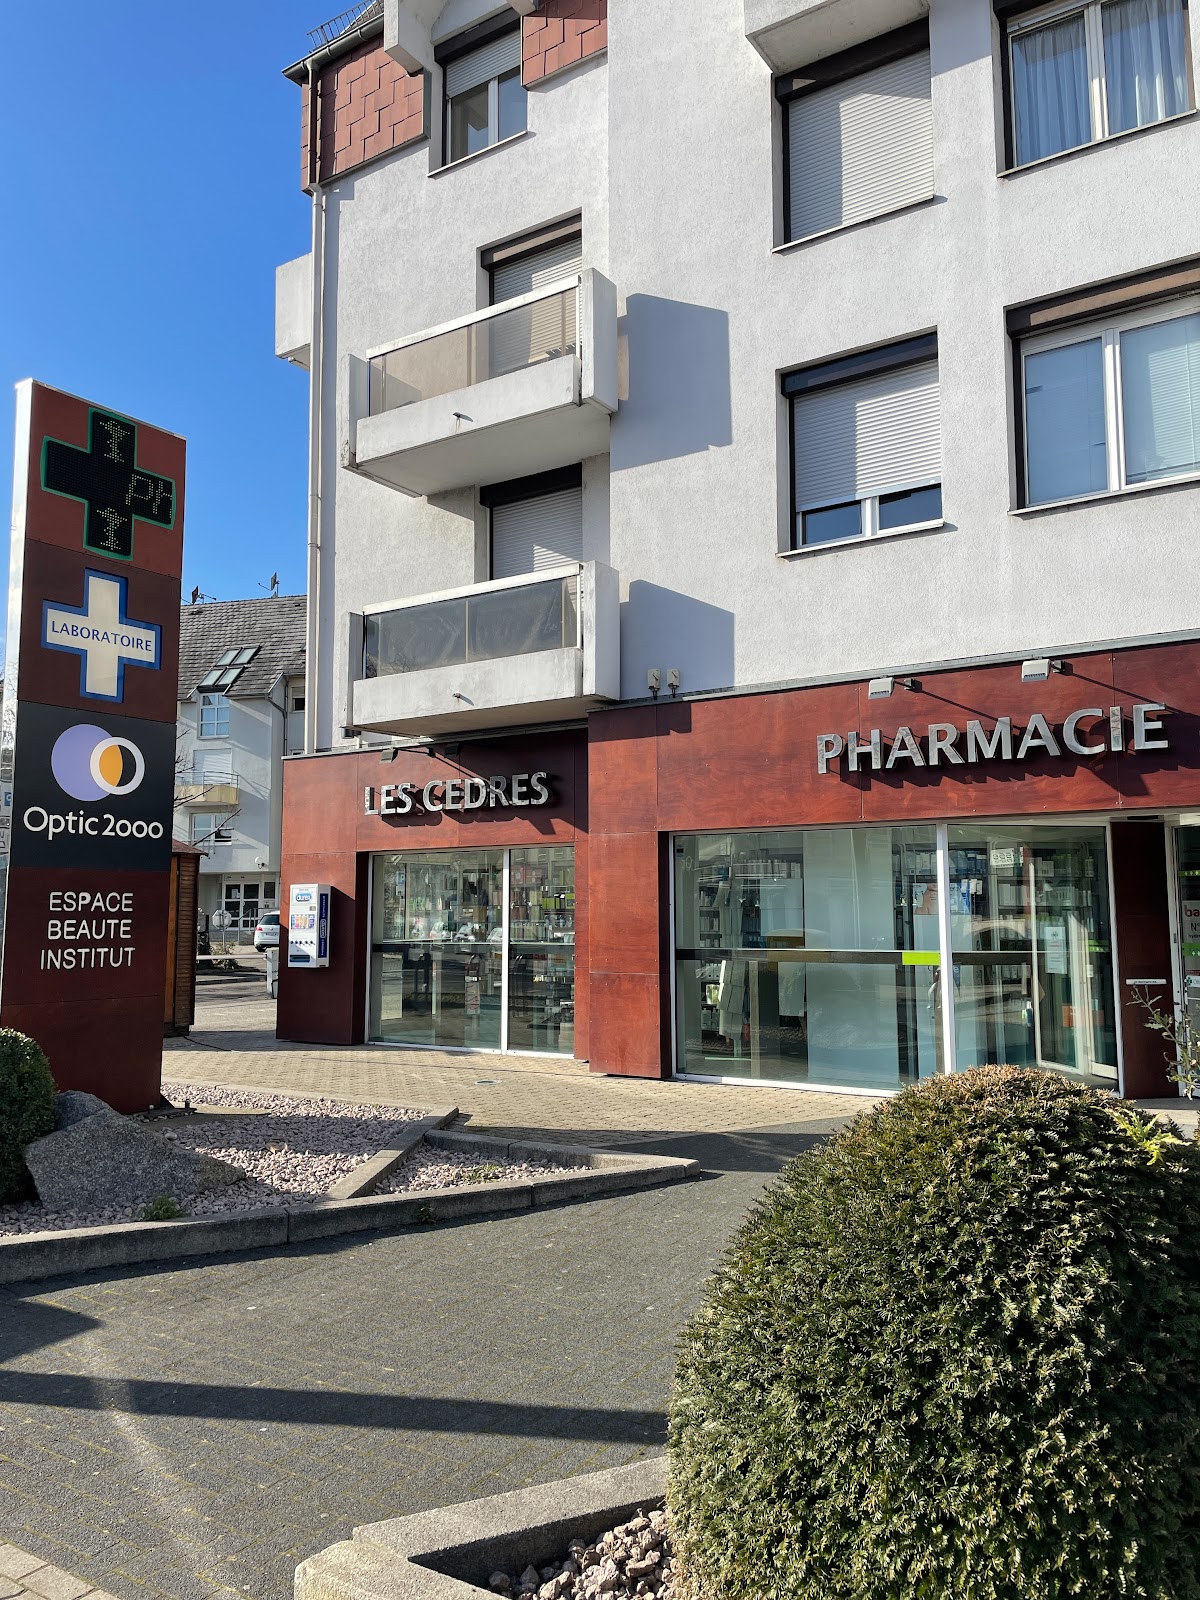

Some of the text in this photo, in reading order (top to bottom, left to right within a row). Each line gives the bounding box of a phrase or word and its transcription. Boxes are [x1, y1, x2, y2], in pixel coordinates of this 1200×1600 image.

[51, 620, 153, 652] LABORATOIRE
[816, 703, 1169, 774] PHARMACIE
[364, 772, 549, 816] LES CEDRES
[23, 806, 163, 840] Optic 2000
[49, 891, 134, 912] ESPACE
[47, 919, 132, 940] BEAUTE
[40, 947, 135, 970] INSTITUT
